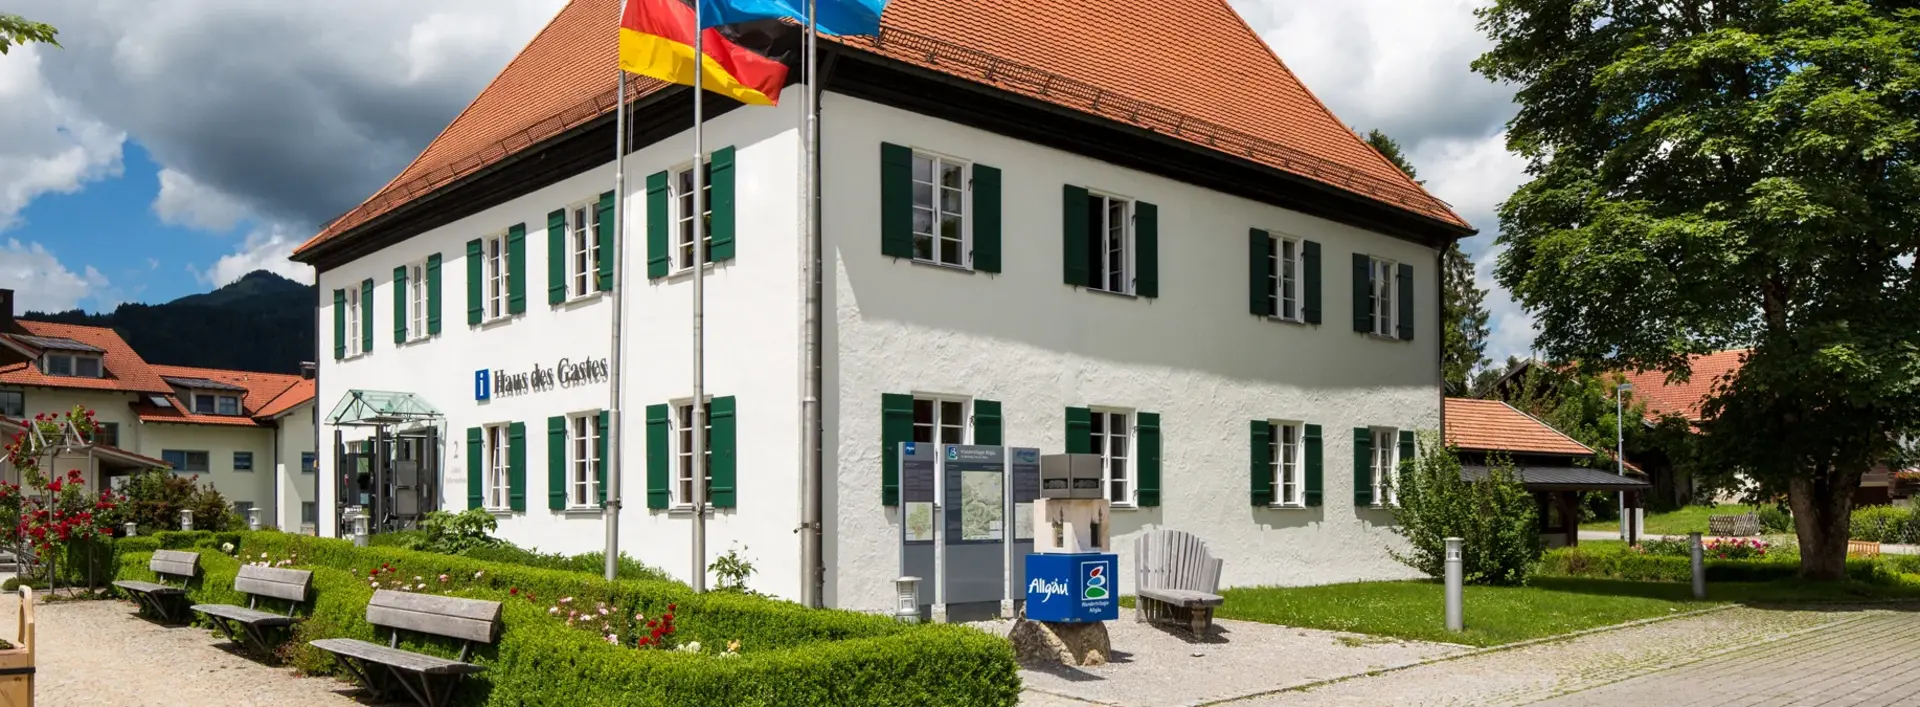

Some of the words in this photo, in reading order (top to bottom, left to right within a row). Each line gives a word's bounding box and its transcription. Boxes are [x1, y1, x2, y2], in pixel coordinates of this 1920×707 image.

[493, 369, 528, 394] Haus
[530, 363, 553, 390] des
[557, 355, 609, 385] Gastes
[1028, 577, 1069, 603] Allgäu
